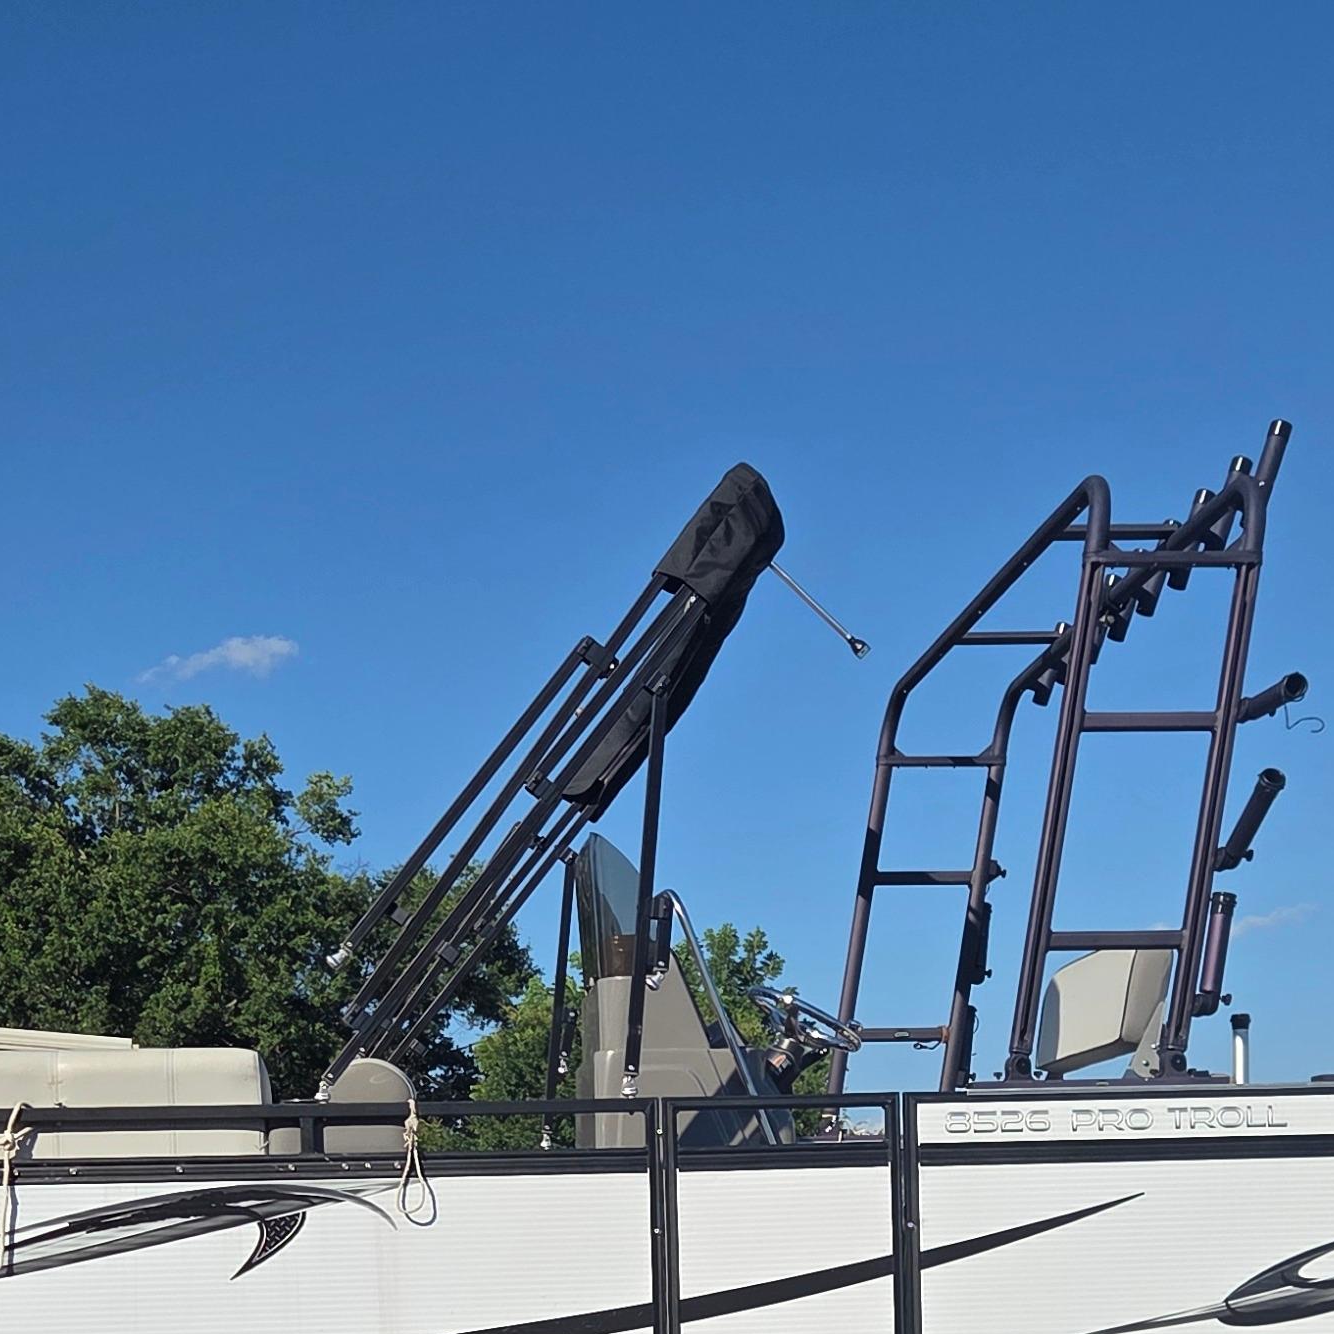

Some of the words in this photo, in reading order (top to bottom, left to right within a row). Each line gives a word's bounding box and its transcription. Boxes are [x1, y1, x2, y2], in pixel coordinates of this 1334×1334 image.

[944, 1109, 1052, 1134] 8526
[1071, 1107, 1154, 1132] PRO
[1167, 1105, 1288, 1130] TROLL
